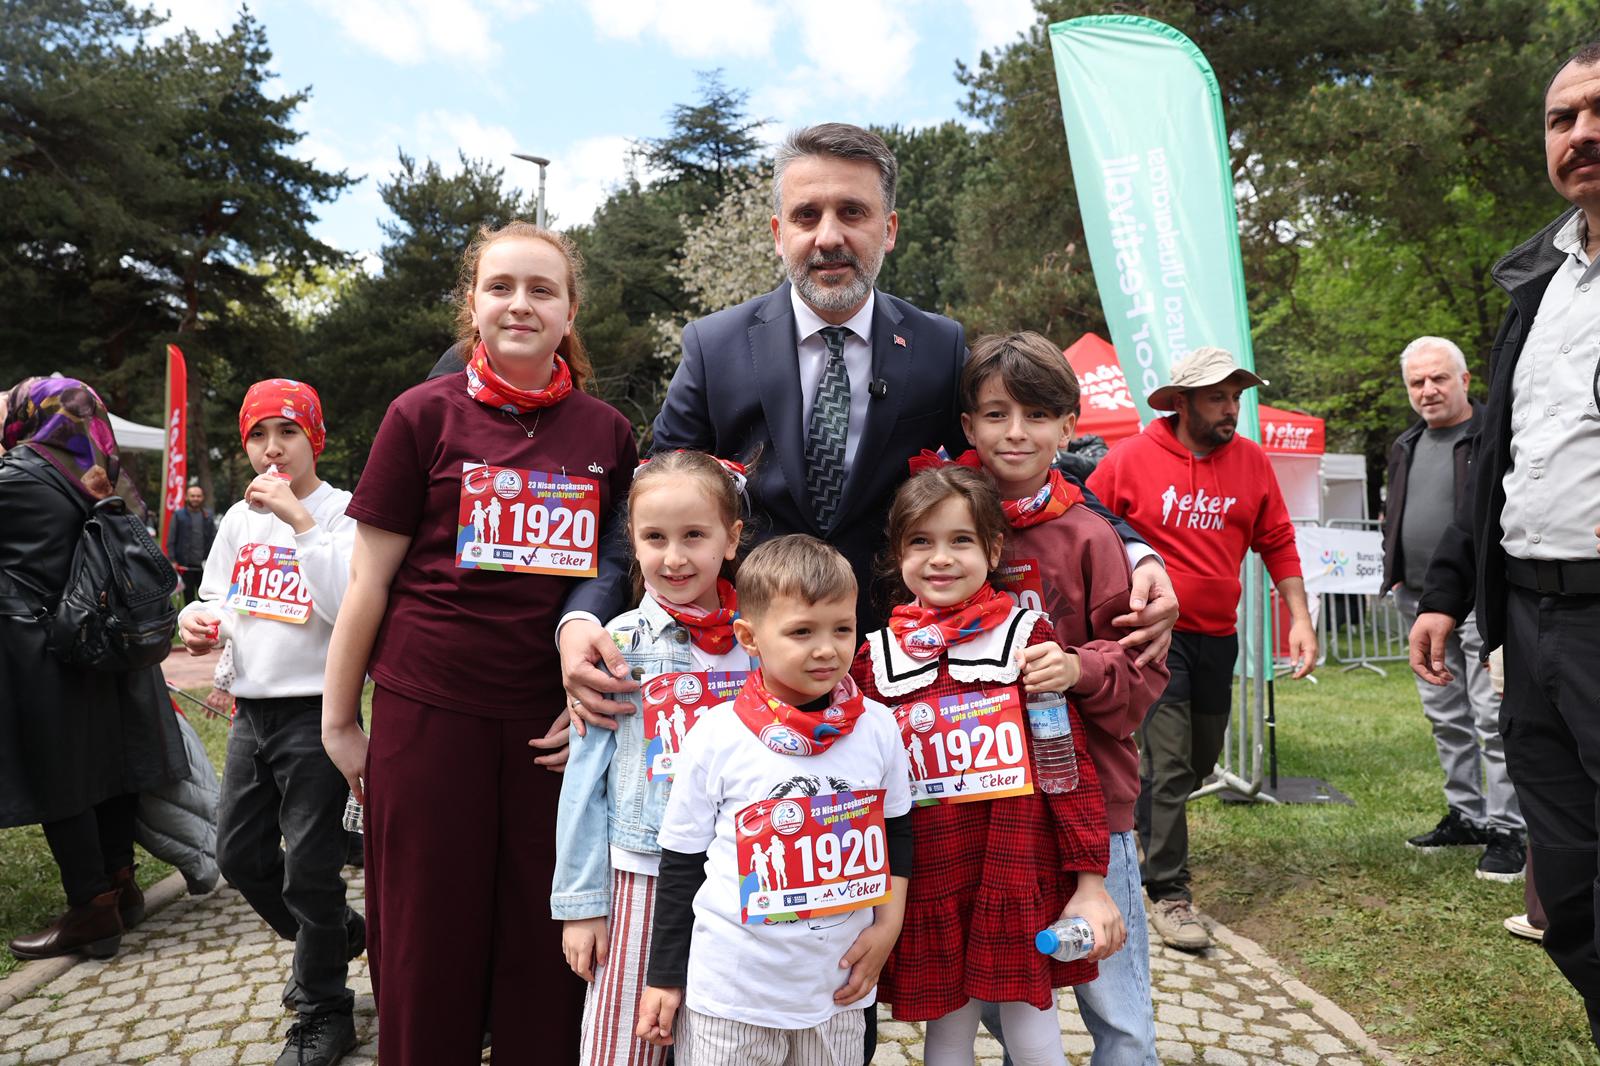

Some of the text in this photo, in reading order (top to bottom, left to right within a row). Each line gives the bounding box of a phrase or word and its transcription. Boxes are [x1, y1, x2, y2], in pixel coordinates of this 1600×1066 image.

[1277, 422, 1314, 438] eker
[1281, 438, 1308, 450] RUN
[587, 462, 604, 474] alo
[528, 481, 594, 492] 23 Nisan coşkusuyla
[537, 491, 551, 499] yola
[1178, 488, 1237, 514] eker
[509, 503, 595, 549] 1920
[1175, 511, 1225, 530] I RUN
[1356, 563, 1376, 578] Spor
[258, 567, 312, 604] 1920
[707, 682, 716, 690] 23
[716, 680, 735, 689] Nisan
[719, 689, 733, 698] yola
[940, 707, 949, 716] 23
[949, 703, 969, 714] Nisan
[951, 712, 967, 723] yola
[928, 721, 1023, 774] 1920
[811, 808, 820, 817] 23
[821, 804, 842, 815] Nisan
[823, 815, 839, 826] yola
[794, 825, 885, 883] 1920
